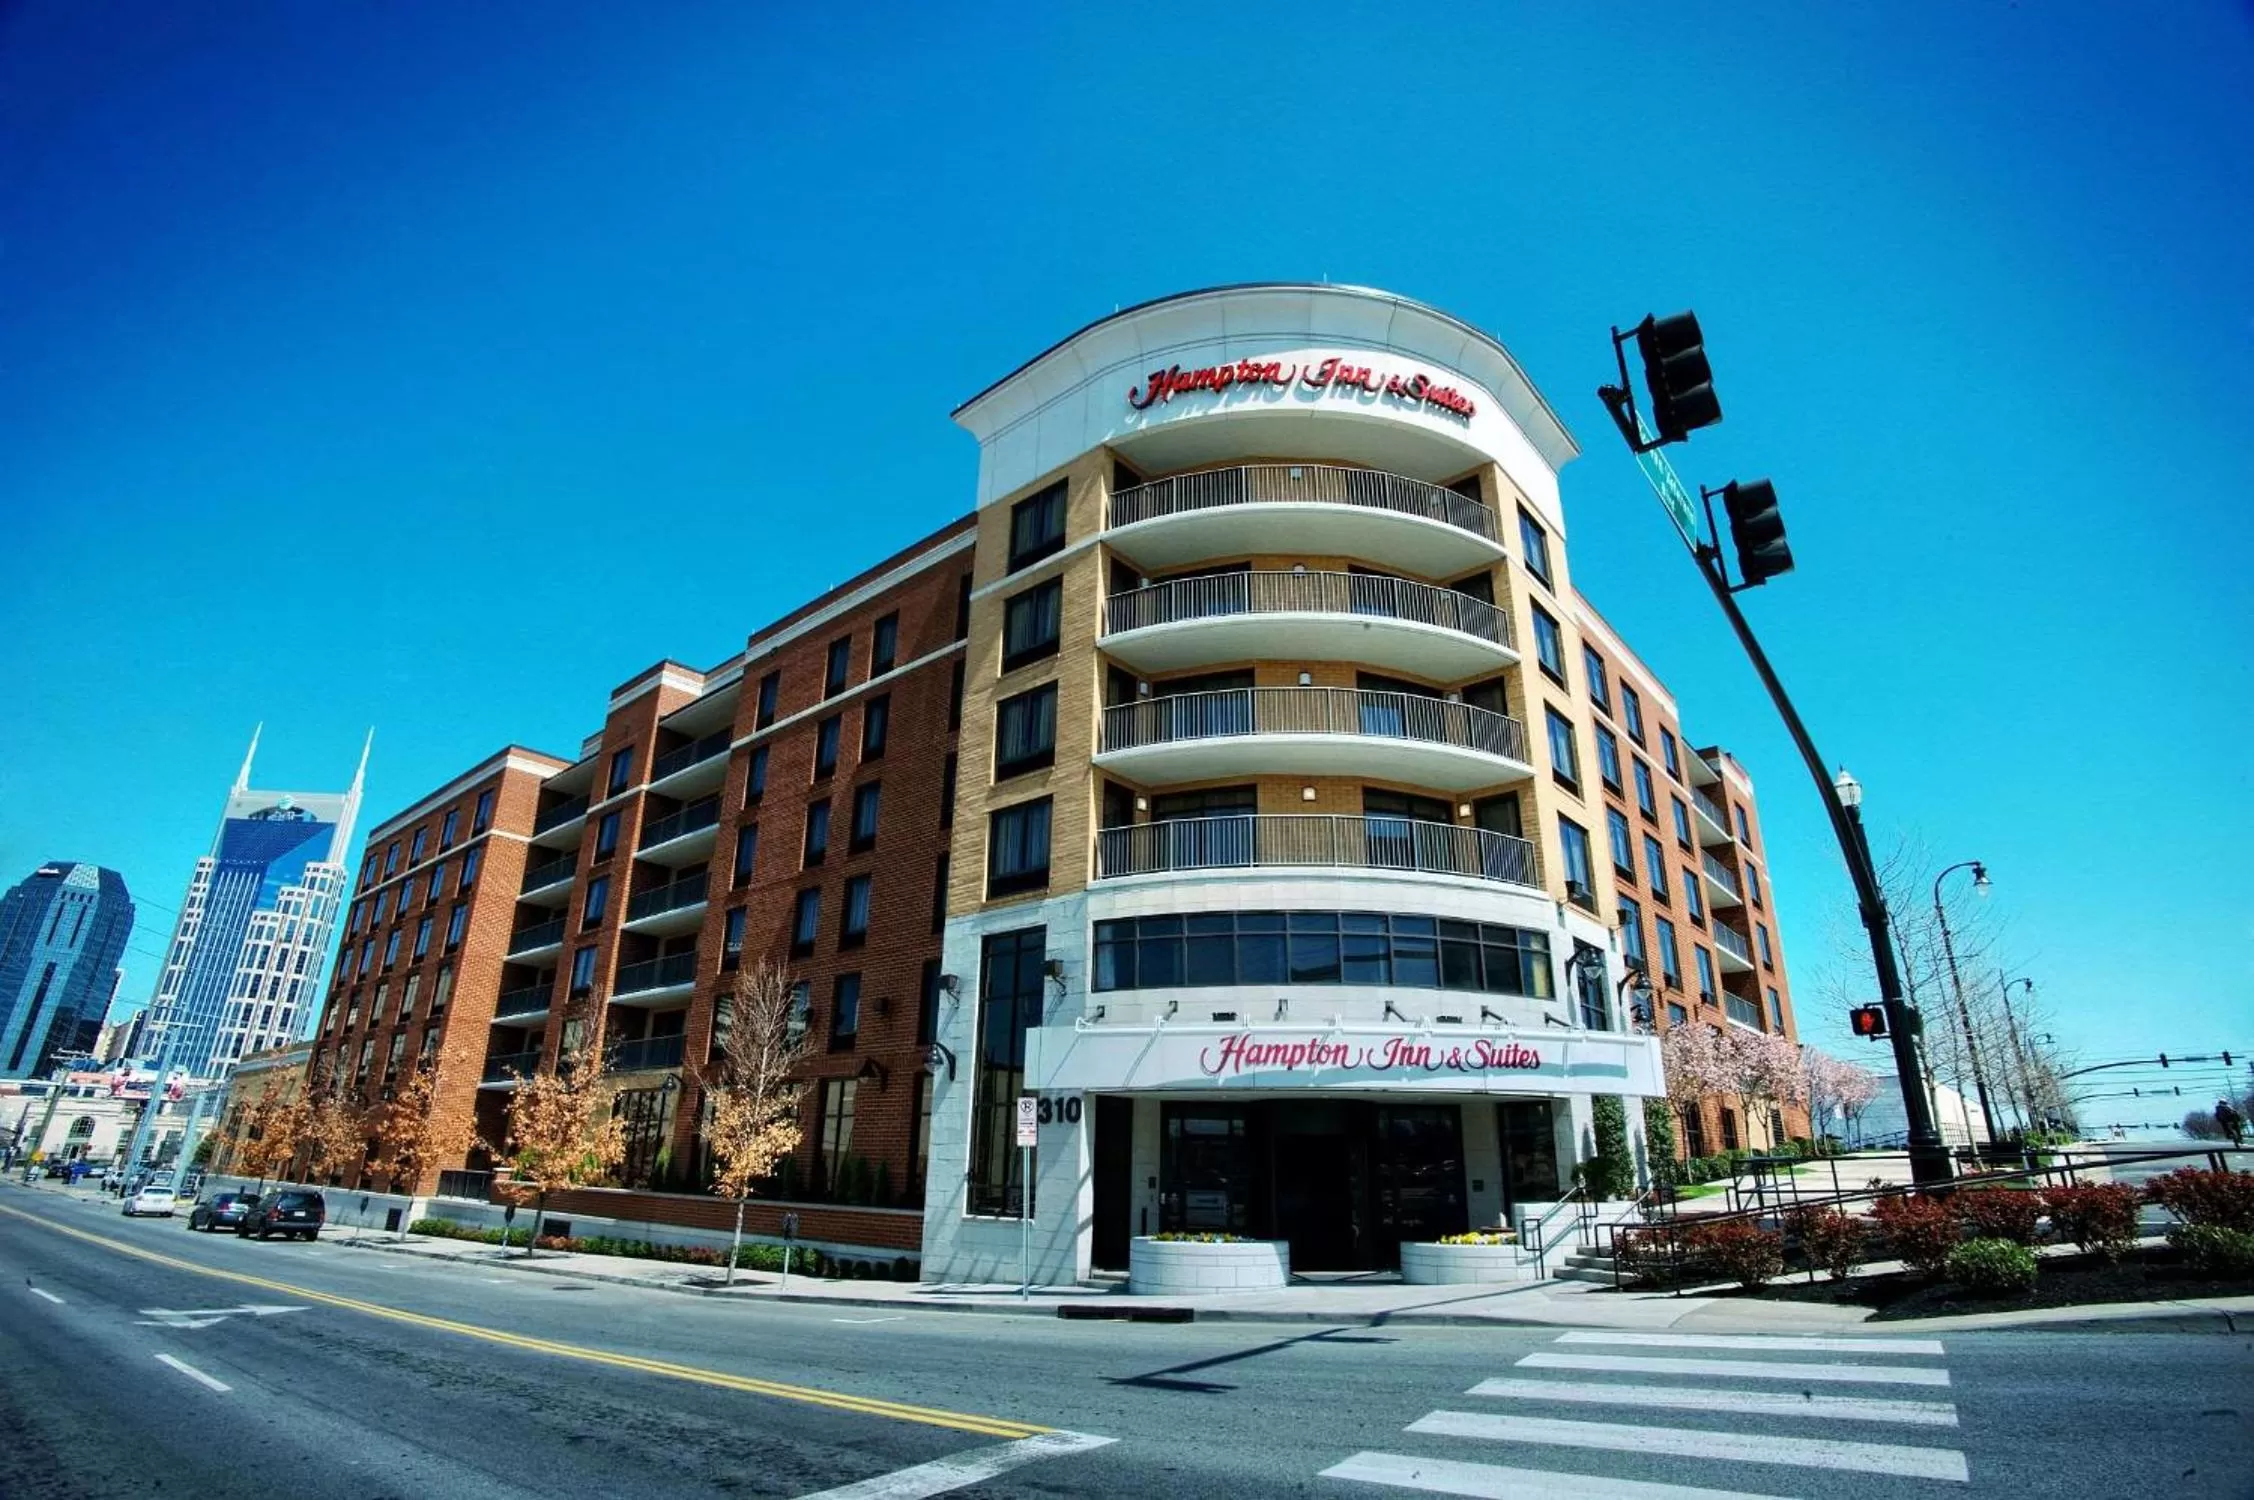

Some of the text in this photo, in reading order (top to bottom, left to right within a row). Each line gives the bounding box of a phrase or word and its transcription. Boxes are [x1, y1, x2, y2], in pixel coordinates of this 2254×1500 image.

[1128, 358, 1296, 410] Hampton
[1303, 357, 1386, 391] Inn
[1403, 373, 1476, 419] Suites
[1200, 1032, 1541, 1076] Hampton Inn & Suites
[1037, 1096, 1082, 1125] 310
